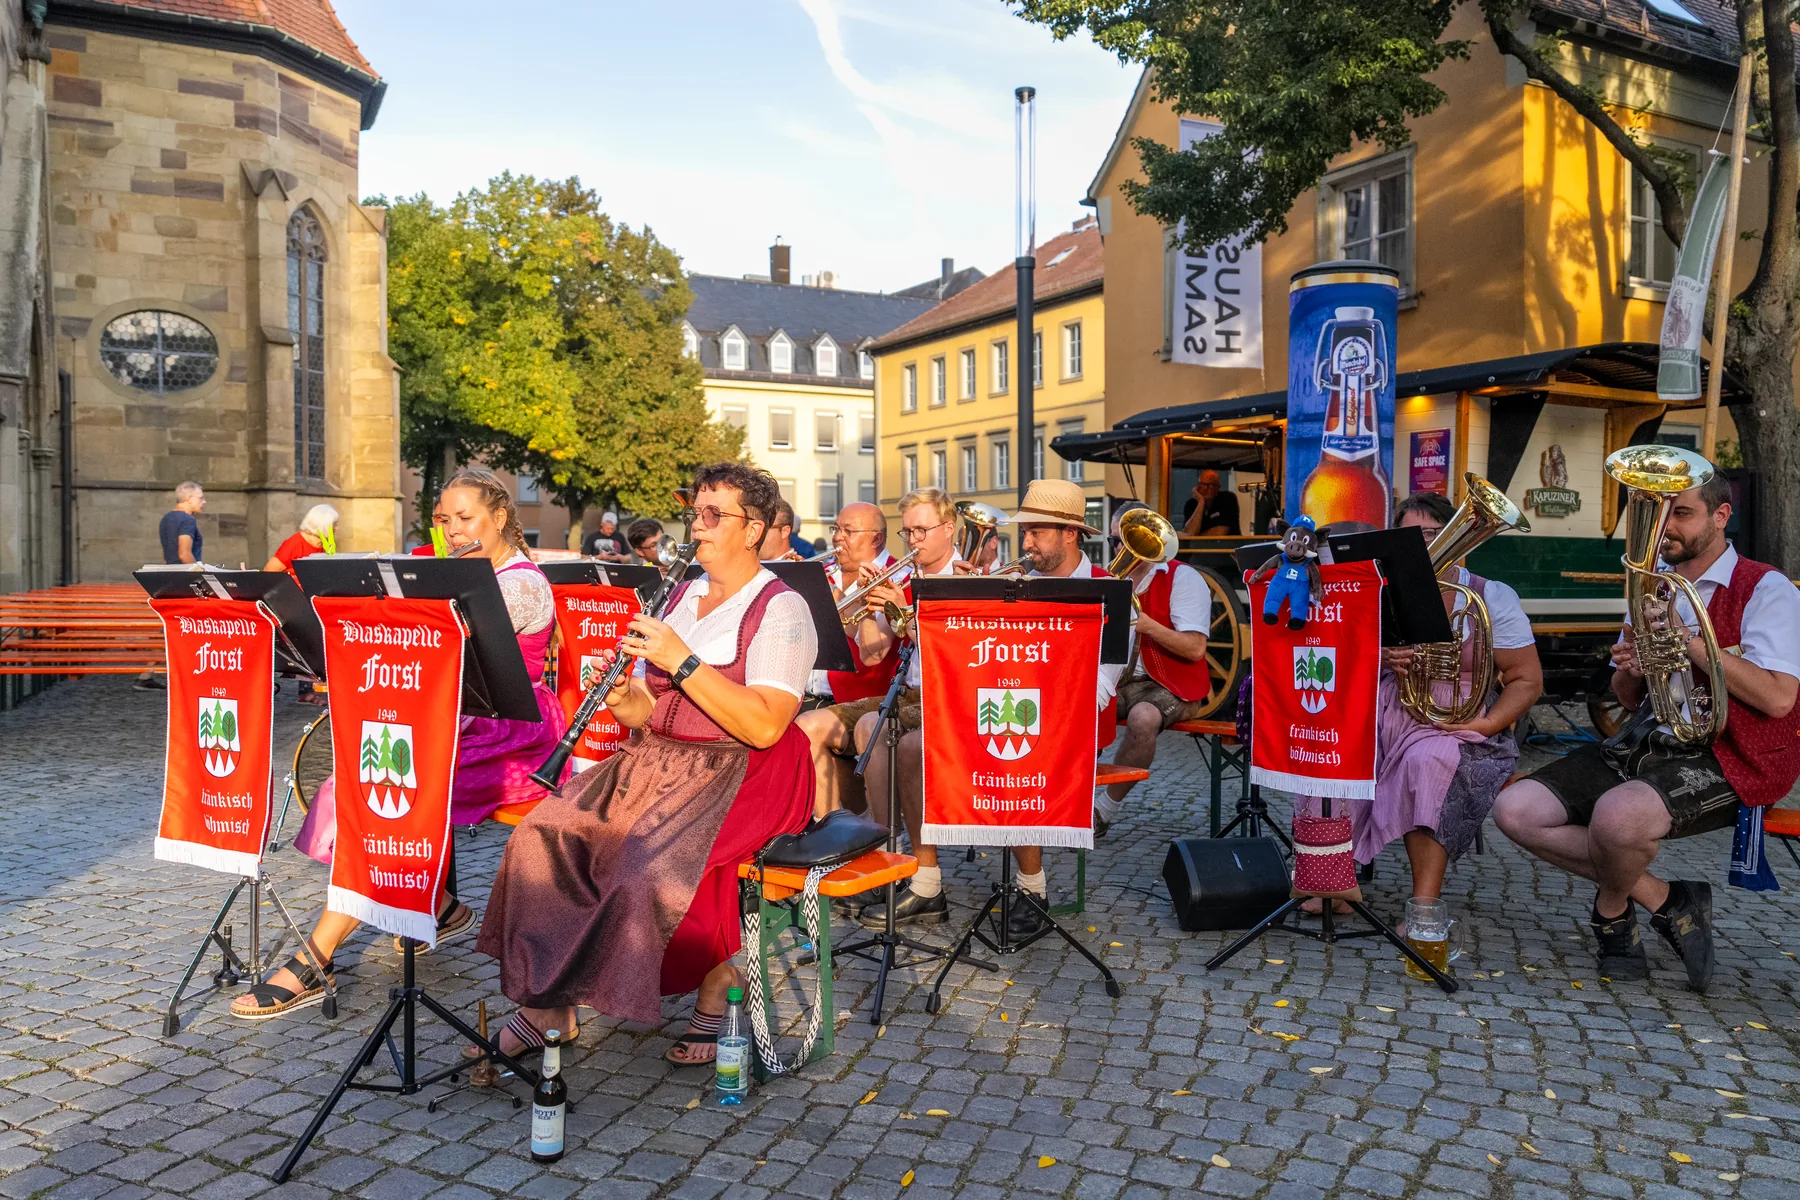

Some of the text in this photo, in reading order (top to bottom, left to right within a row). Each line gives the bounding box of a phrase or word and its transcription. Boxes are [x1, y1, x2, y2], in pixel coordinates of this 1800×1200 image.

[1414, 455, 1446, 468] SAFE SPACE
[1533, 490, 1577, 505] KAPUZINER
[564, 596, 629, 616] Blaskapelle
[174, 615, 257, 639] Blaskapelle
[577, 617, 618, 640] Forst
[944, 616, 1075, 634] Blaskapelle
[337, 619, 443, 651] Blaskapelle
[1305, 637, 1321, 645] 1949
[193, 642, 244, 675] Forst
[967, 636, 1051, 668] Forst
[357, 653, 423, 693] Forst
[997, 678, 1021, 687] 1949
[211, 687, 227, 697] 1949
[377, 708, 397, 721] 1949
[588, 720, 620, 737] nkisch
[1289, 723, 1339, 746] fränkisch
[1289, 745, 1341, 767] böhmisch
[972, 771, 1047, 789] fränkisch
[972, 794, 1046, 813] böhmisch
[361, 832, 433, 862] ränkisch
[368, 864, 430, 894] öhmisch
[534, 1107, 557, 1117] ROTH
